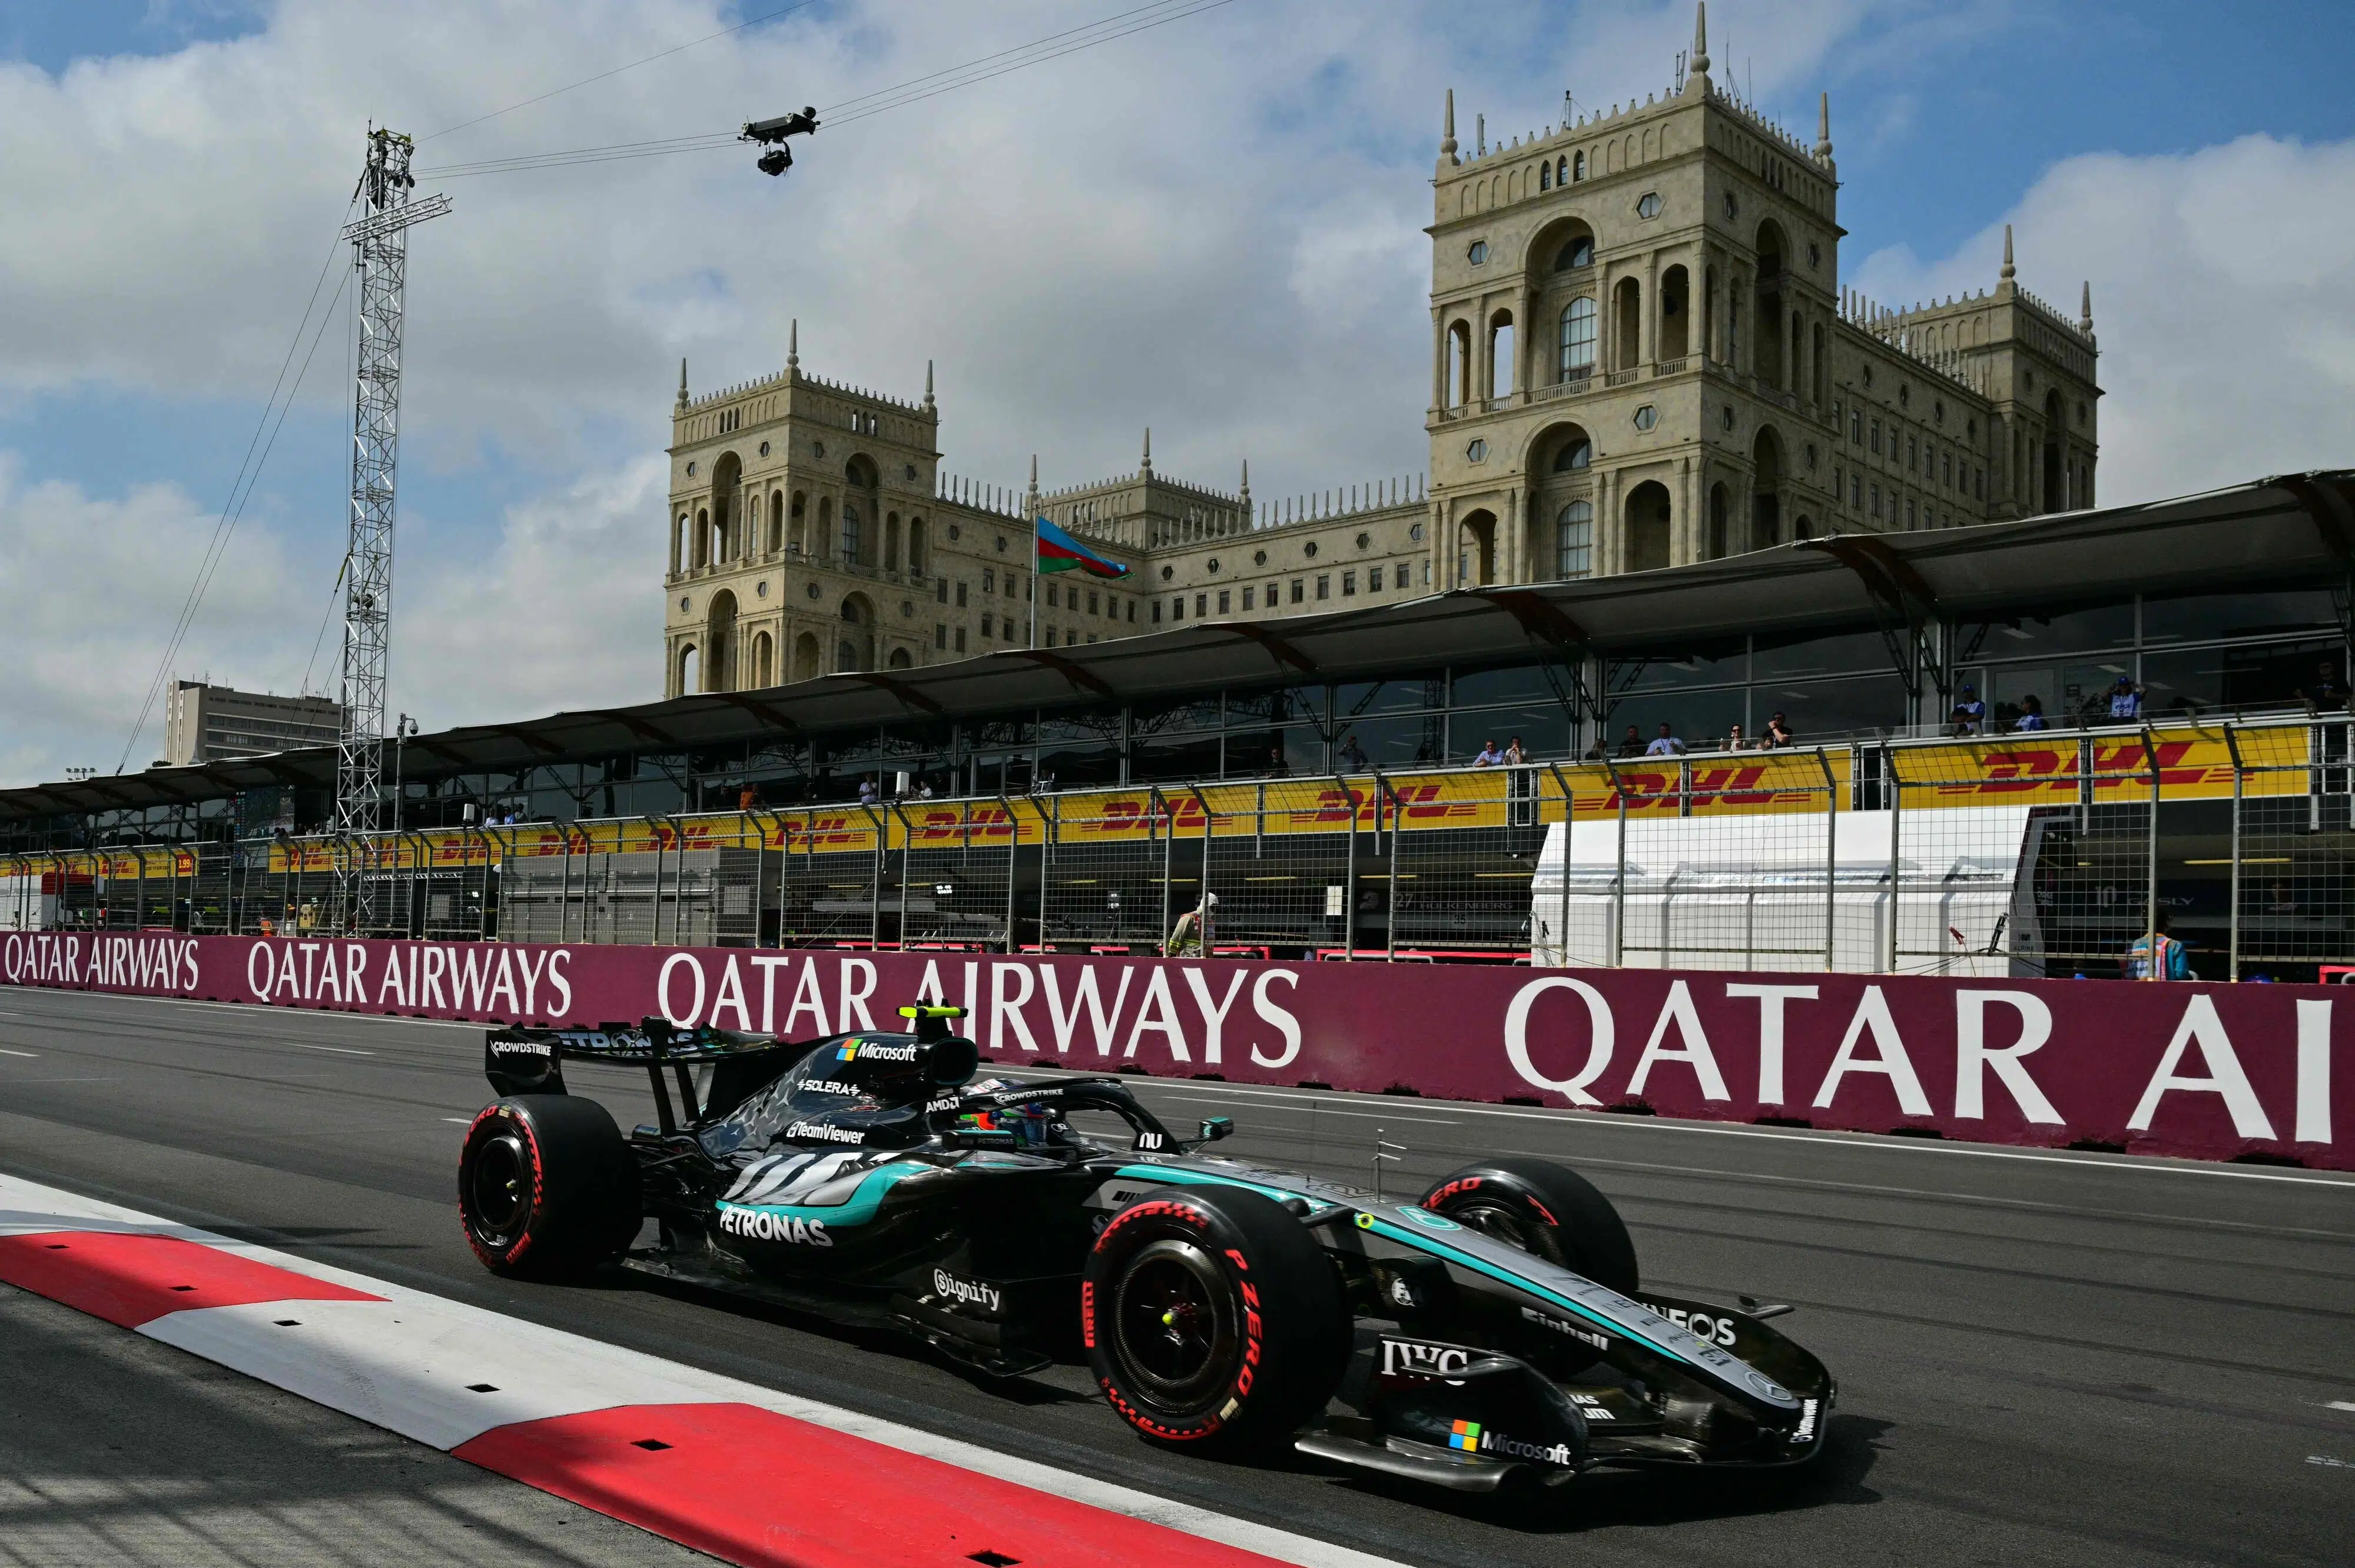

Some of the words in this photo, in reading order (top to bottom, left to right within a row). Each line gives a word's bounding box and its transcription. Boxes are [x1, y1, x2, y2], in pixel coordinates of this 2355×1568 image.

[1977, 742, 2207, 793] DHL
[1315, 785, 1450, 822] DHL
[1604, 768, 1774, 810] DHL
[920, 808, 1017, 839] DHL
[1097, 798, 1209, 831] DHL
[648, 826, 714, 851] DHL
[774, 818, 851, 846] DHL
[1395, 892, 1414, 908] 27
[1454, 915, 1466, 924] 35
[5, 934, 79, 984] QATAR
[85, 936, 199, 991] AIRWAYS
[247, 940, 368, 1003] QATAR
[378, 944, 571, 1018] AIRWAYS
[658, 952, 877, 1037] QATAR
[907, 958, 1301, 1068] AIRWAYS
[494, 1041, 551, 1057] CROWDSTRIKE
[858, 1042, 917, 1061] Microsoft
[1505, 976, 2067, 1125] QATAR
[2127, 994, 2333, 1144] AI
[804, 1079, 850, 1095] SOLERA
[999, 1089, 1064, 1102] CROWDSTRIKE
[925, 1098, 952, 1113] AMD
[797, 1121, 865, 1144] TeamViewer
[1422, 1177, 1483, 1210] ERO
[720, 1205, 834, 1247] PETRONAS
[1225, 1249, 1248, 1270] P
[1238, 1280, 1263, 1397] ZERO
[1521, 1307, 1608, 1351] Einhell
[1641, 1302, 1736, 1346] NEOS
[1380, 1340, 1468, 1386] IWC
[1481, 1430, 1571, 1466] Microsoft
